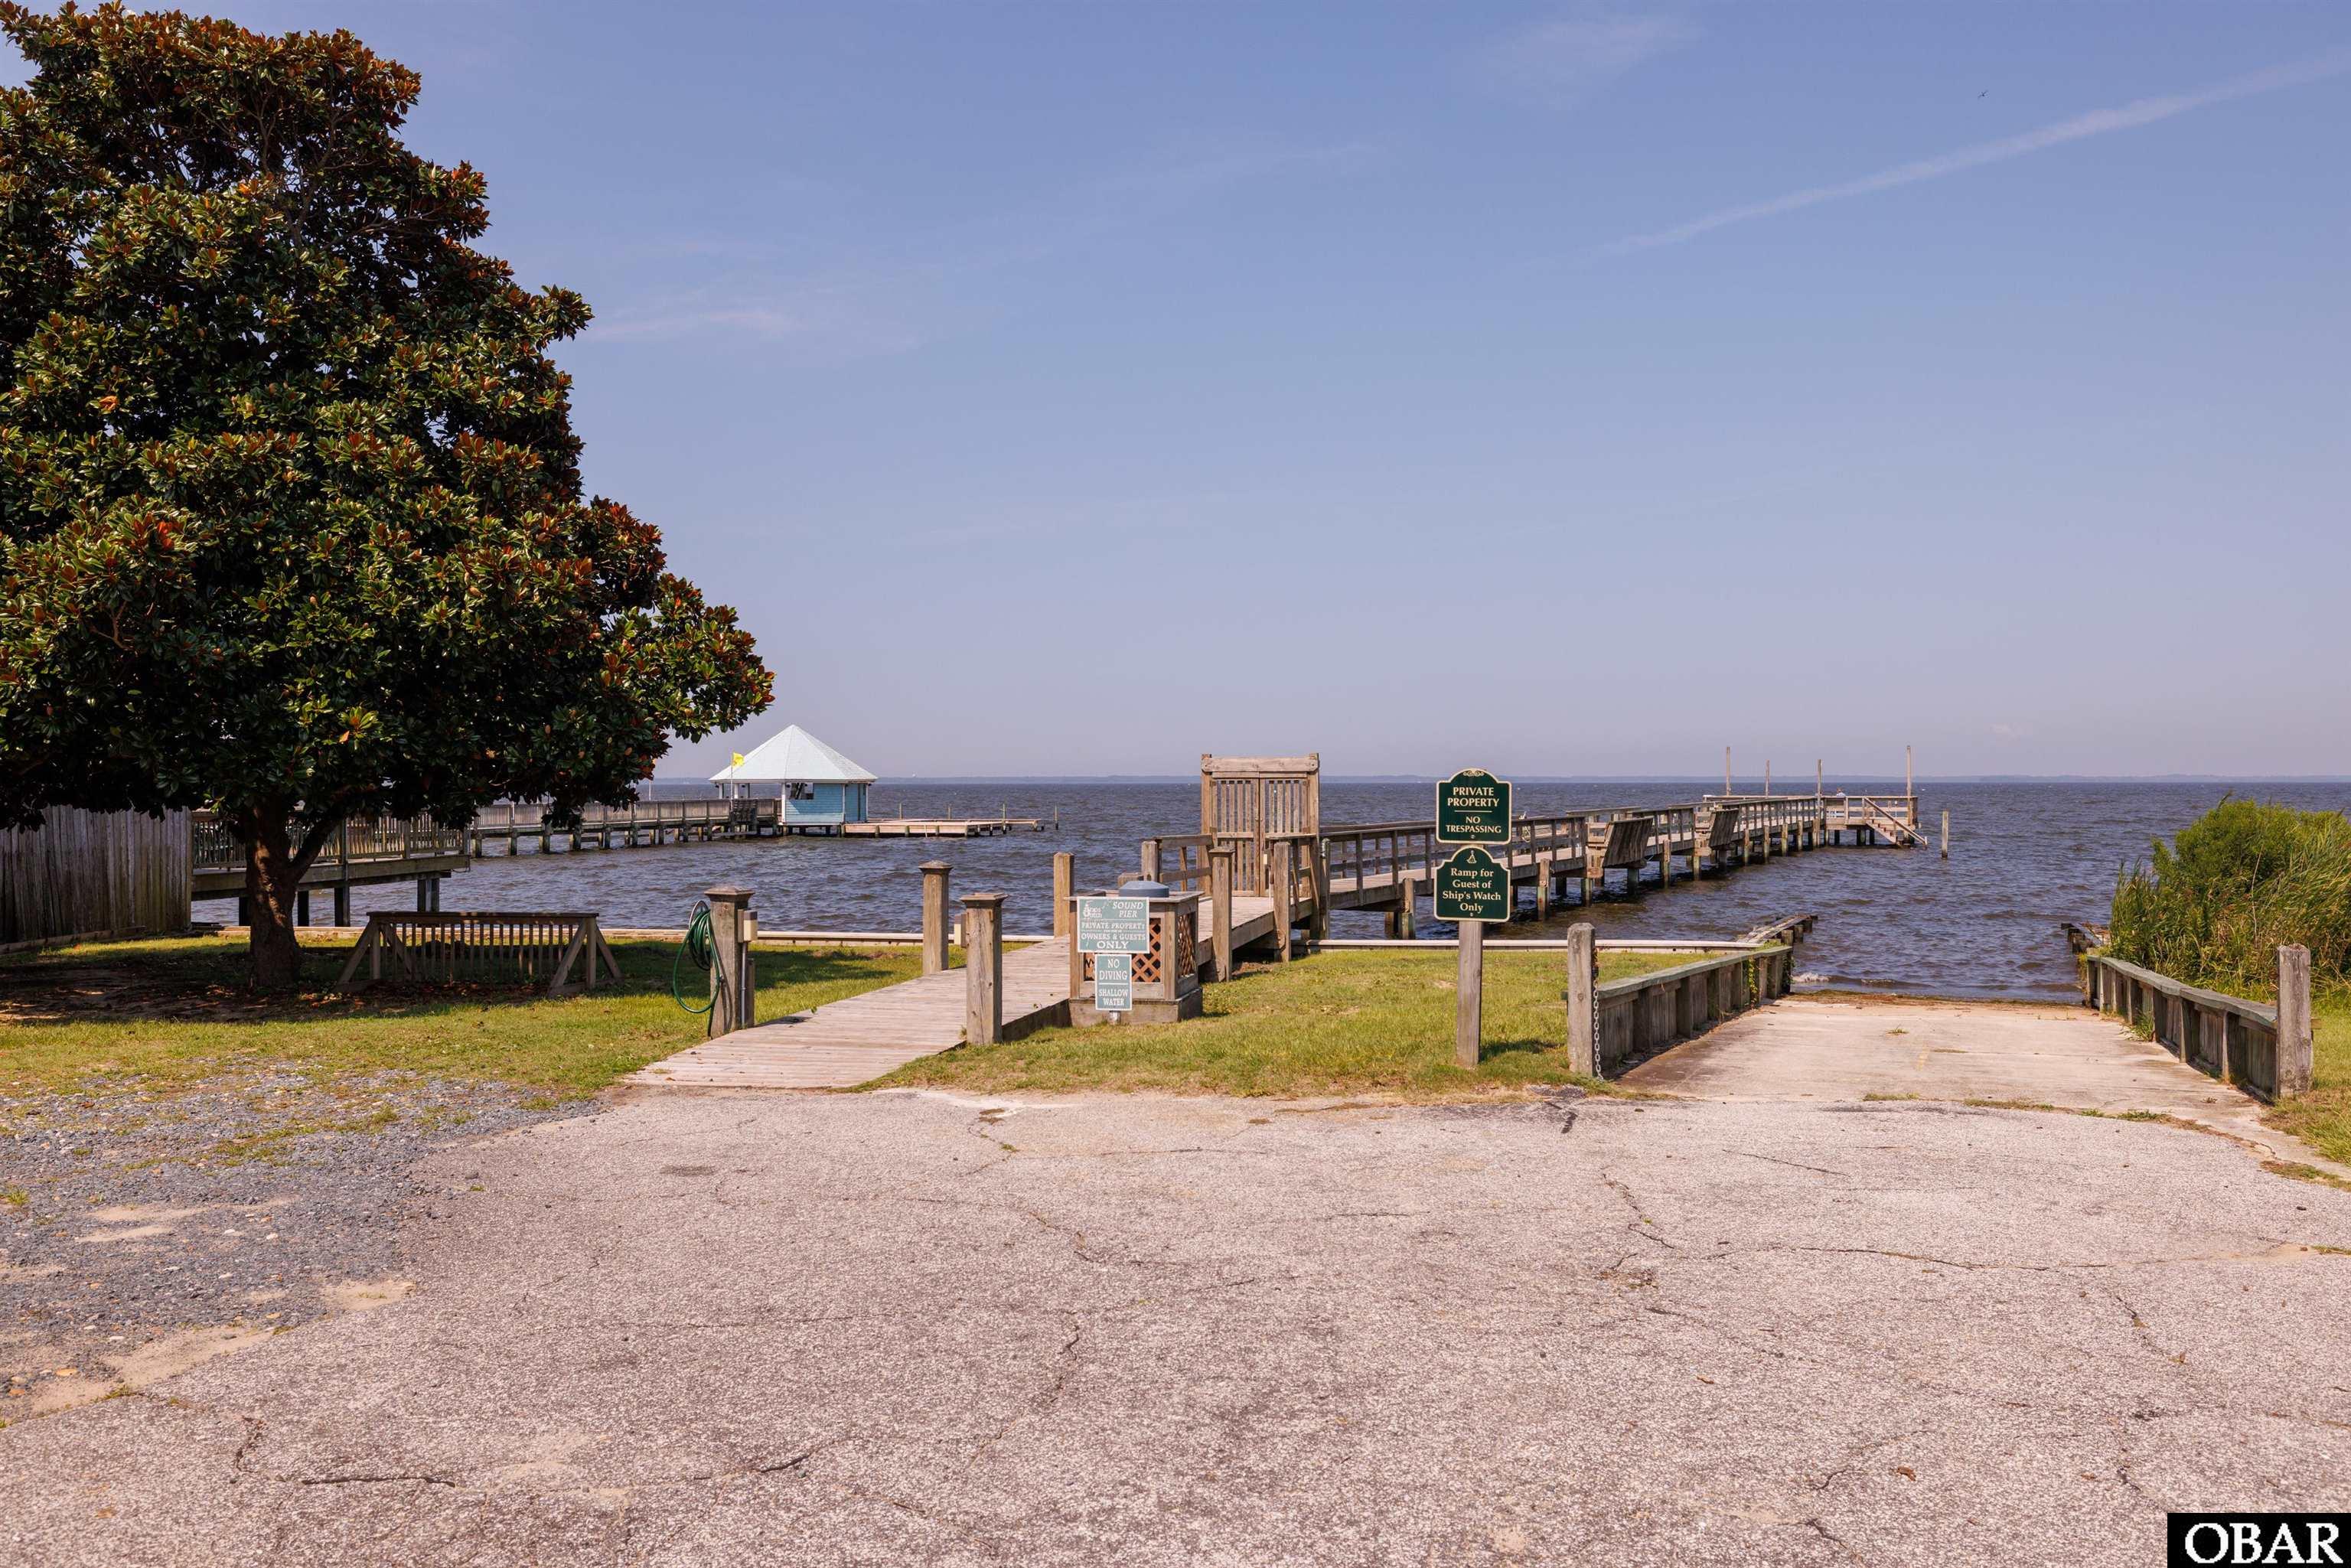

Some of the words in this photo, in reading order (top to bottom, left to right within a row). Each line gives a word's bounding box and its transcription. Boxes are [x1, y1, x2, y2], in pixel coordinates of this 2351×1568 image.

[1453, 787, 1495, 797] PRIVATE
[1447, 797, 1500, 807] PROPERTY
[1466, 816, 1481, 824] NO
[1446, 824, 1502, 833] TRESPASSING
[1450, 868, 1478, 879] Ramp
[1480, 868, 1495, 878] for
[1452, 879, 1480, 889] Guest
[1482, 879, 1492, 889] of
[1442, 890, 1471, 901] Ship's
[1472, 892, 1502, 901] Watch
[1113, 901, 1143, 910] SOUND
[1459, 902, 1484, 914] Only
[1119, 910, 1138, 918] PIER
[1097, 940, 1129, 949] ONLY
[1107, 958, 1120, 968] NO
[1099, 970, 1127, 980] DIVING
[1098, 989, 1128, 997] SHALLOW
[1102, 998, 1124, 1006] WATER
